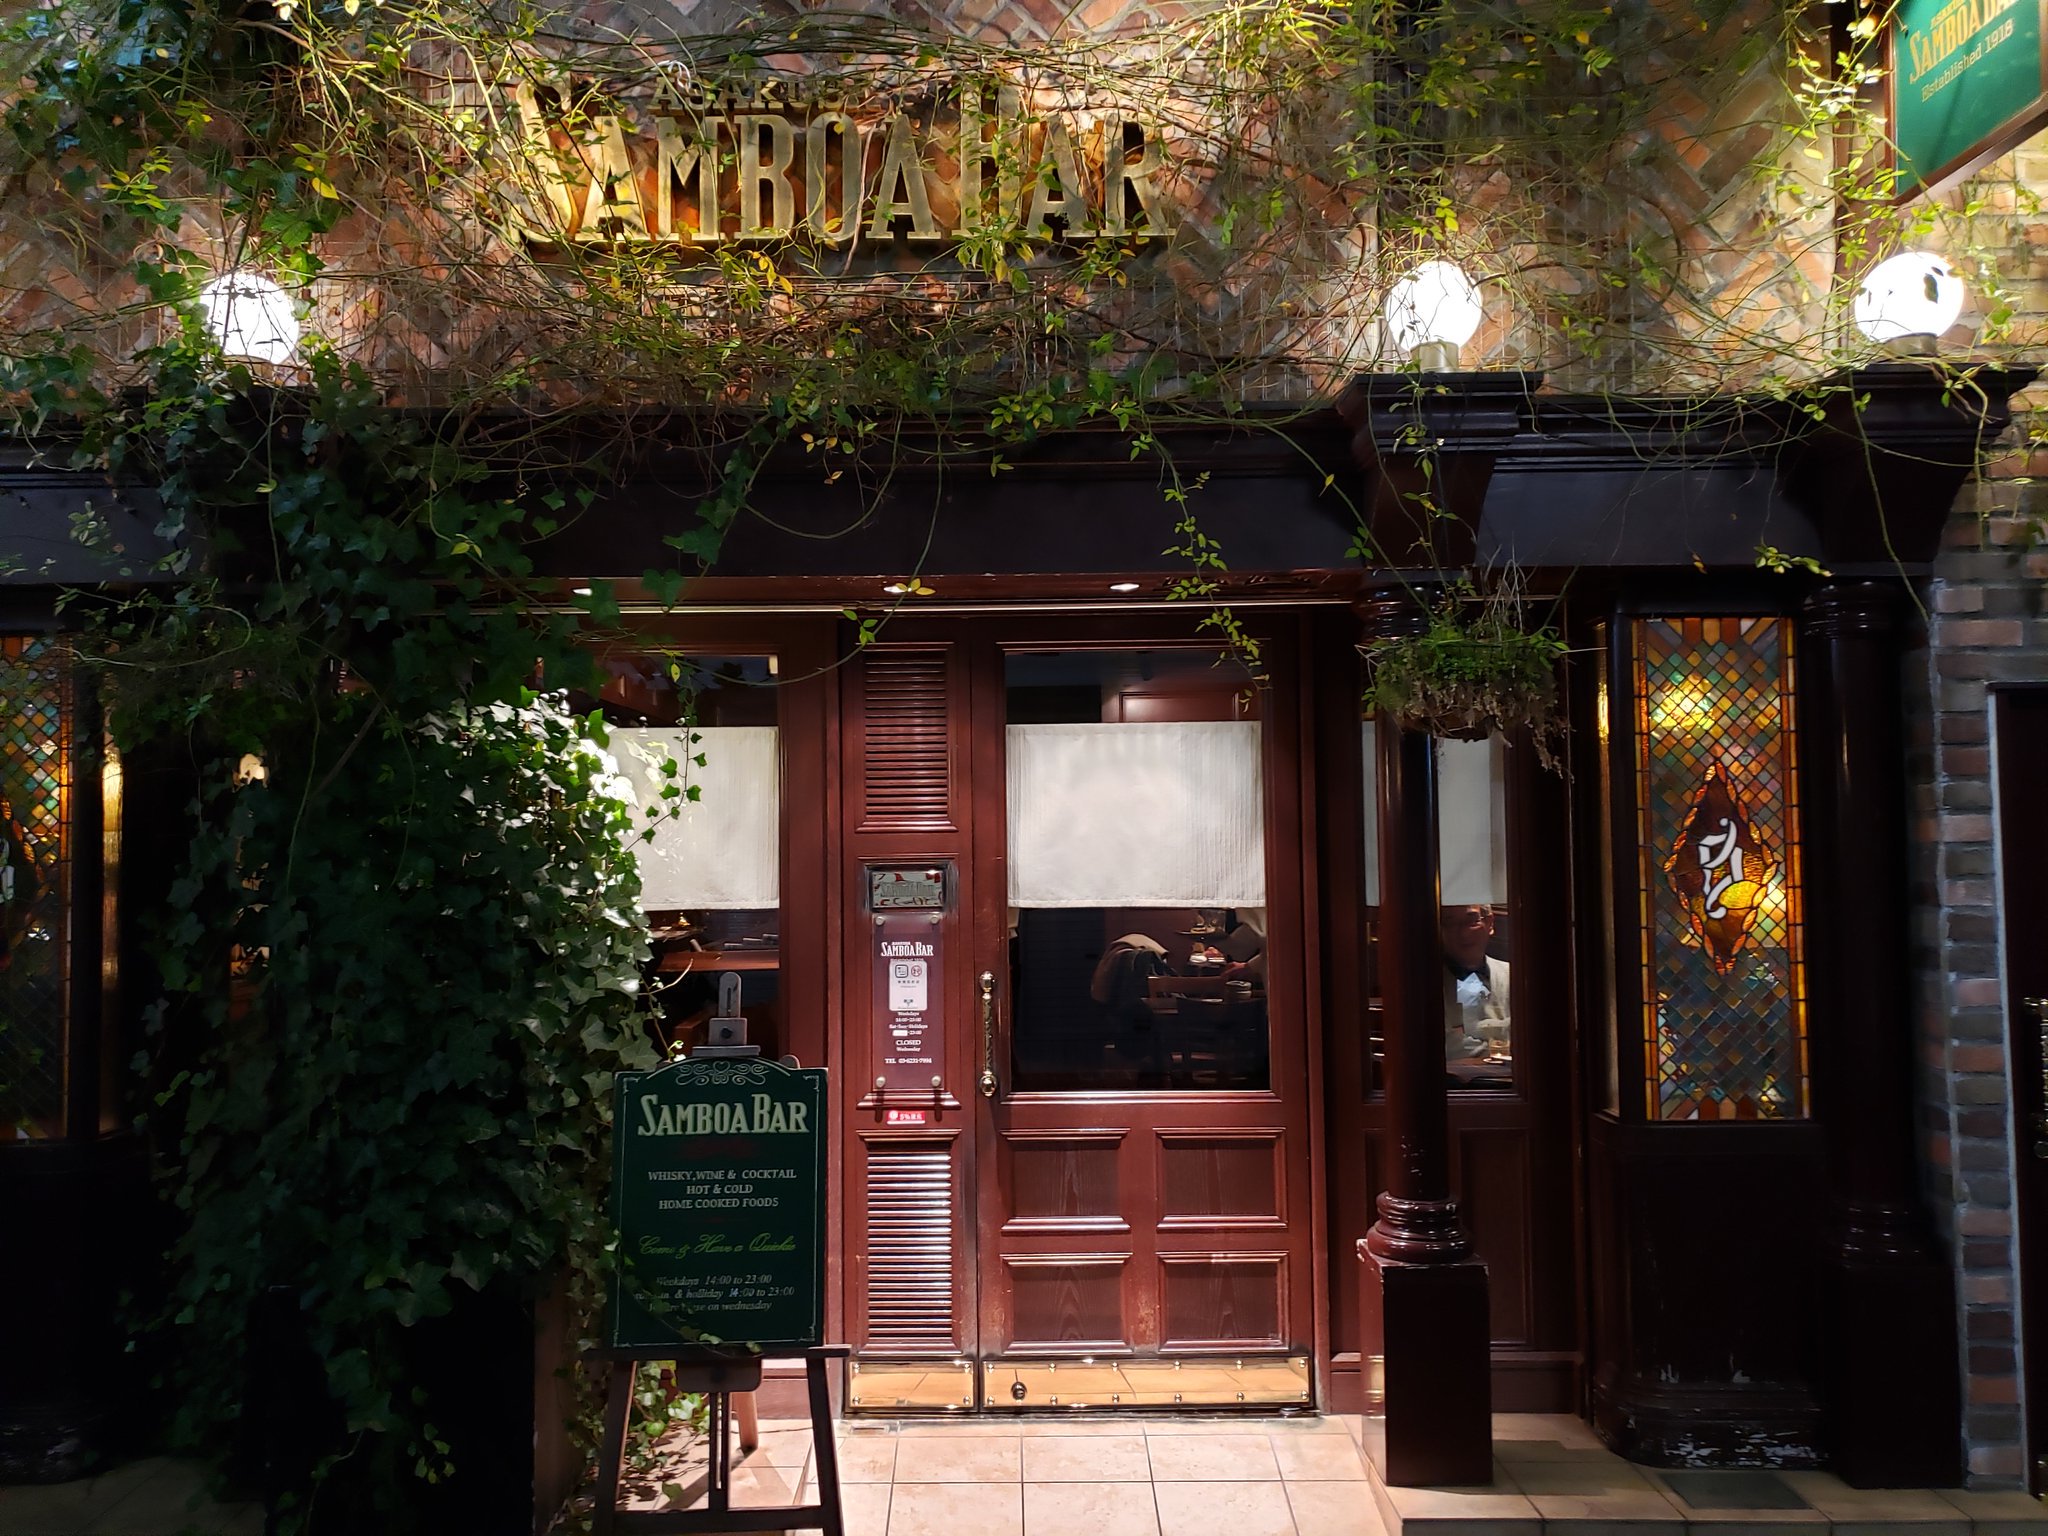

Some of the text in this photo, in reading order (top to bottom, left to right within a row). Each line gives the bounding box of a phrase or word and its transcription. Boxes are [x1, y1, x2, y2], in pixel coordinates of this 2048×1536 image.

[1909, 0, 1981, 84] SAMBOA
[1922, 18, 2014, 102] Established 1918
[497, 78, 942, 244] SAMBOA
[881, 941, 934, 956] SAMBOA BAR
[637, 1093, 810, 1137] SAMBOA BAR
[727, 1169, 737, 1180] &
[742, 1168, 797, 1179] COCKTAIL
[686, 1183, 754, 1195] HOT & COLD
[658, 1197, 779, 1210] HOME COOKED FOODS
[705, 1274, 731, 1285] 14:00
[733, 1276, 743, 1285] to
[744, 1274, 772, 1284] 23:00
[674, 1288, 683, 1299] &
[728, 1287, 754, 1297] 14:00
[756, 1288, 766, 1297] to
[767, 1286, 795, 1296] 23:00
[707, 1303, 720, 1311] on
[721, 1300, 773, 1311] wednesday
